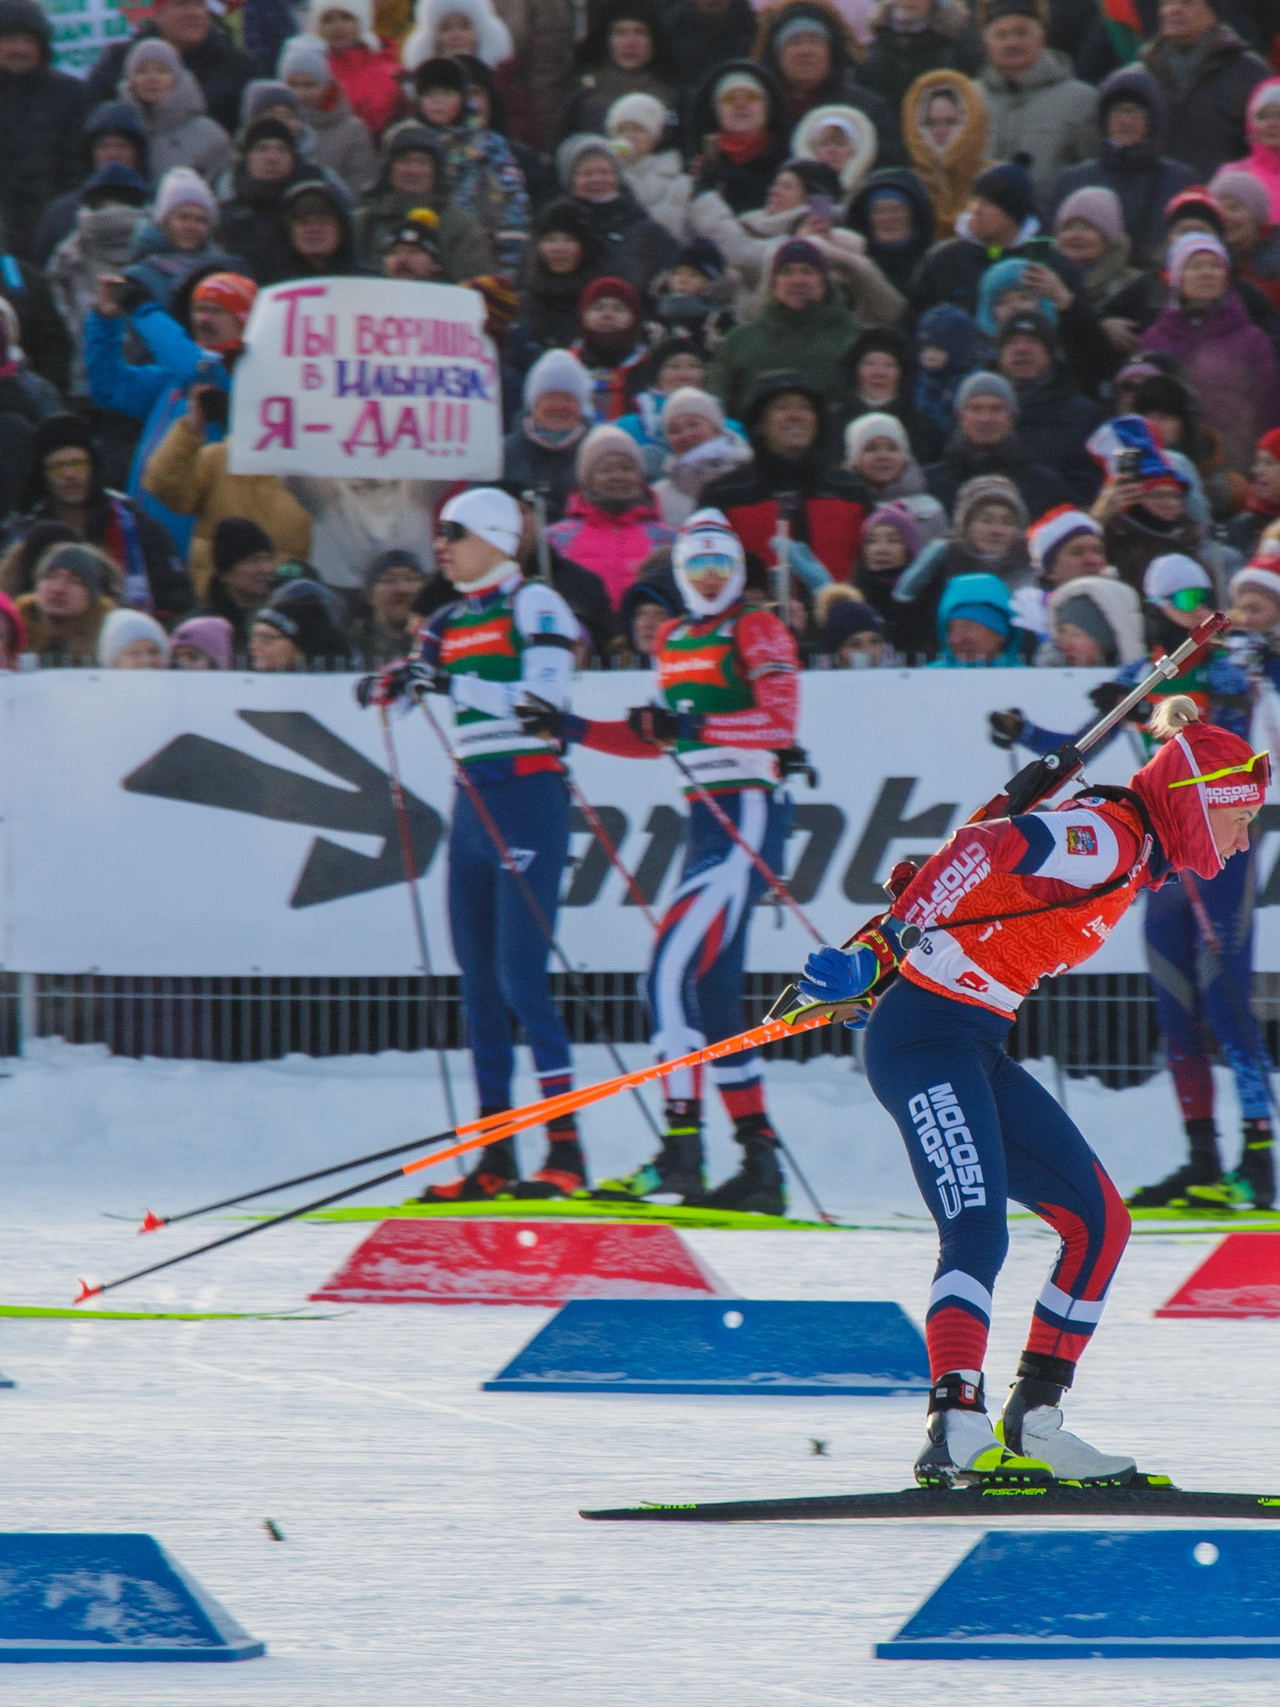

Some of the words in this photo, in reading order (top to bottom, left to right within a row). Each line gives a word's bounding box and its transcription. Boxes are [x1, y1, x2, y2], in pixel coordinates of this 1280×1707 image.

[1206, 792, 1251, 804] ПОРТ
[916, 841, 987, 918] СПОРТ
[908, 1092, 957, 1186] СПОРТ
[927, 1082, 987, 1208] МОСОБЛ
[982, 1487, 1047, 1496] FISCHER
